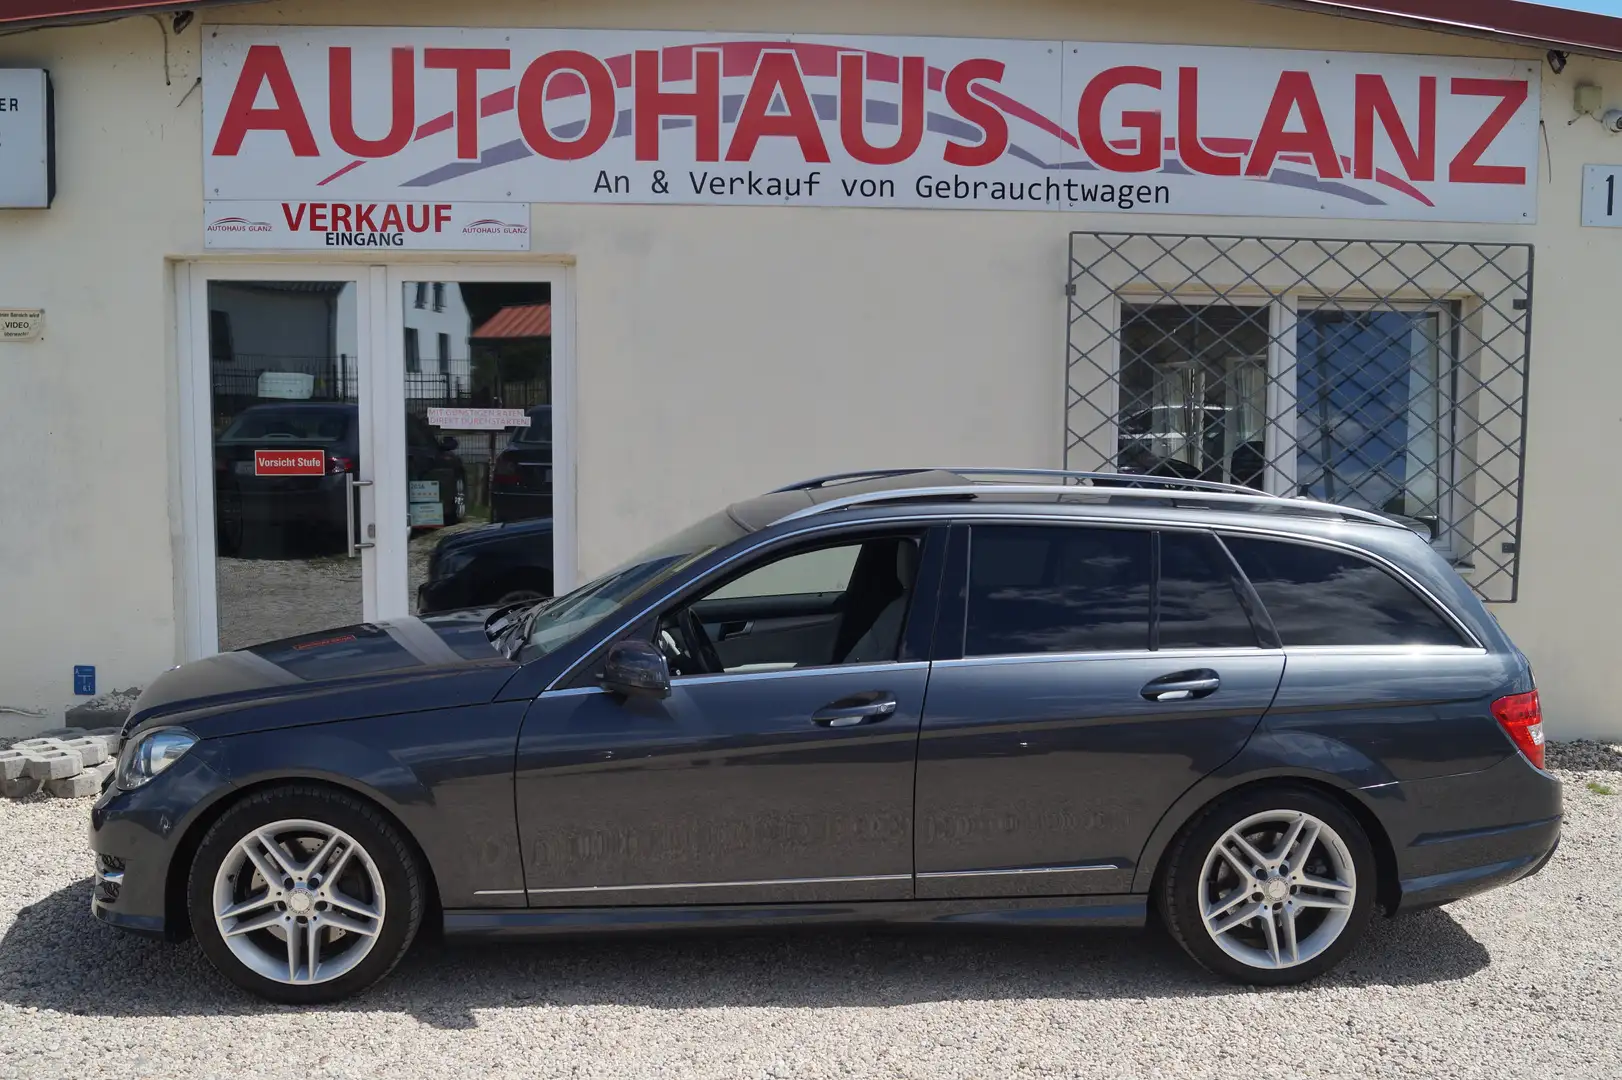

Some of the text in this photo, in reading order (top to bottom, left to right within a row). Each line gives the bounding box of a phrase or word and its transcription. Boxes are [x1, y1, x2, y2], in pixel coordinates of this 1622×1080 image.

[212, 44, 1528, 185] AUTOHAUS GLANZ
[594, 169, 1170, 210] An & Verkauf von Gebrauchtwagen
[281, 202, 452, 234] VERKAUF
[325, 232, 403, 247] EINGANG
[4, 321, 29, 329] VIDEO
[258, 457, 321, 467] Vorsicht Stufe
